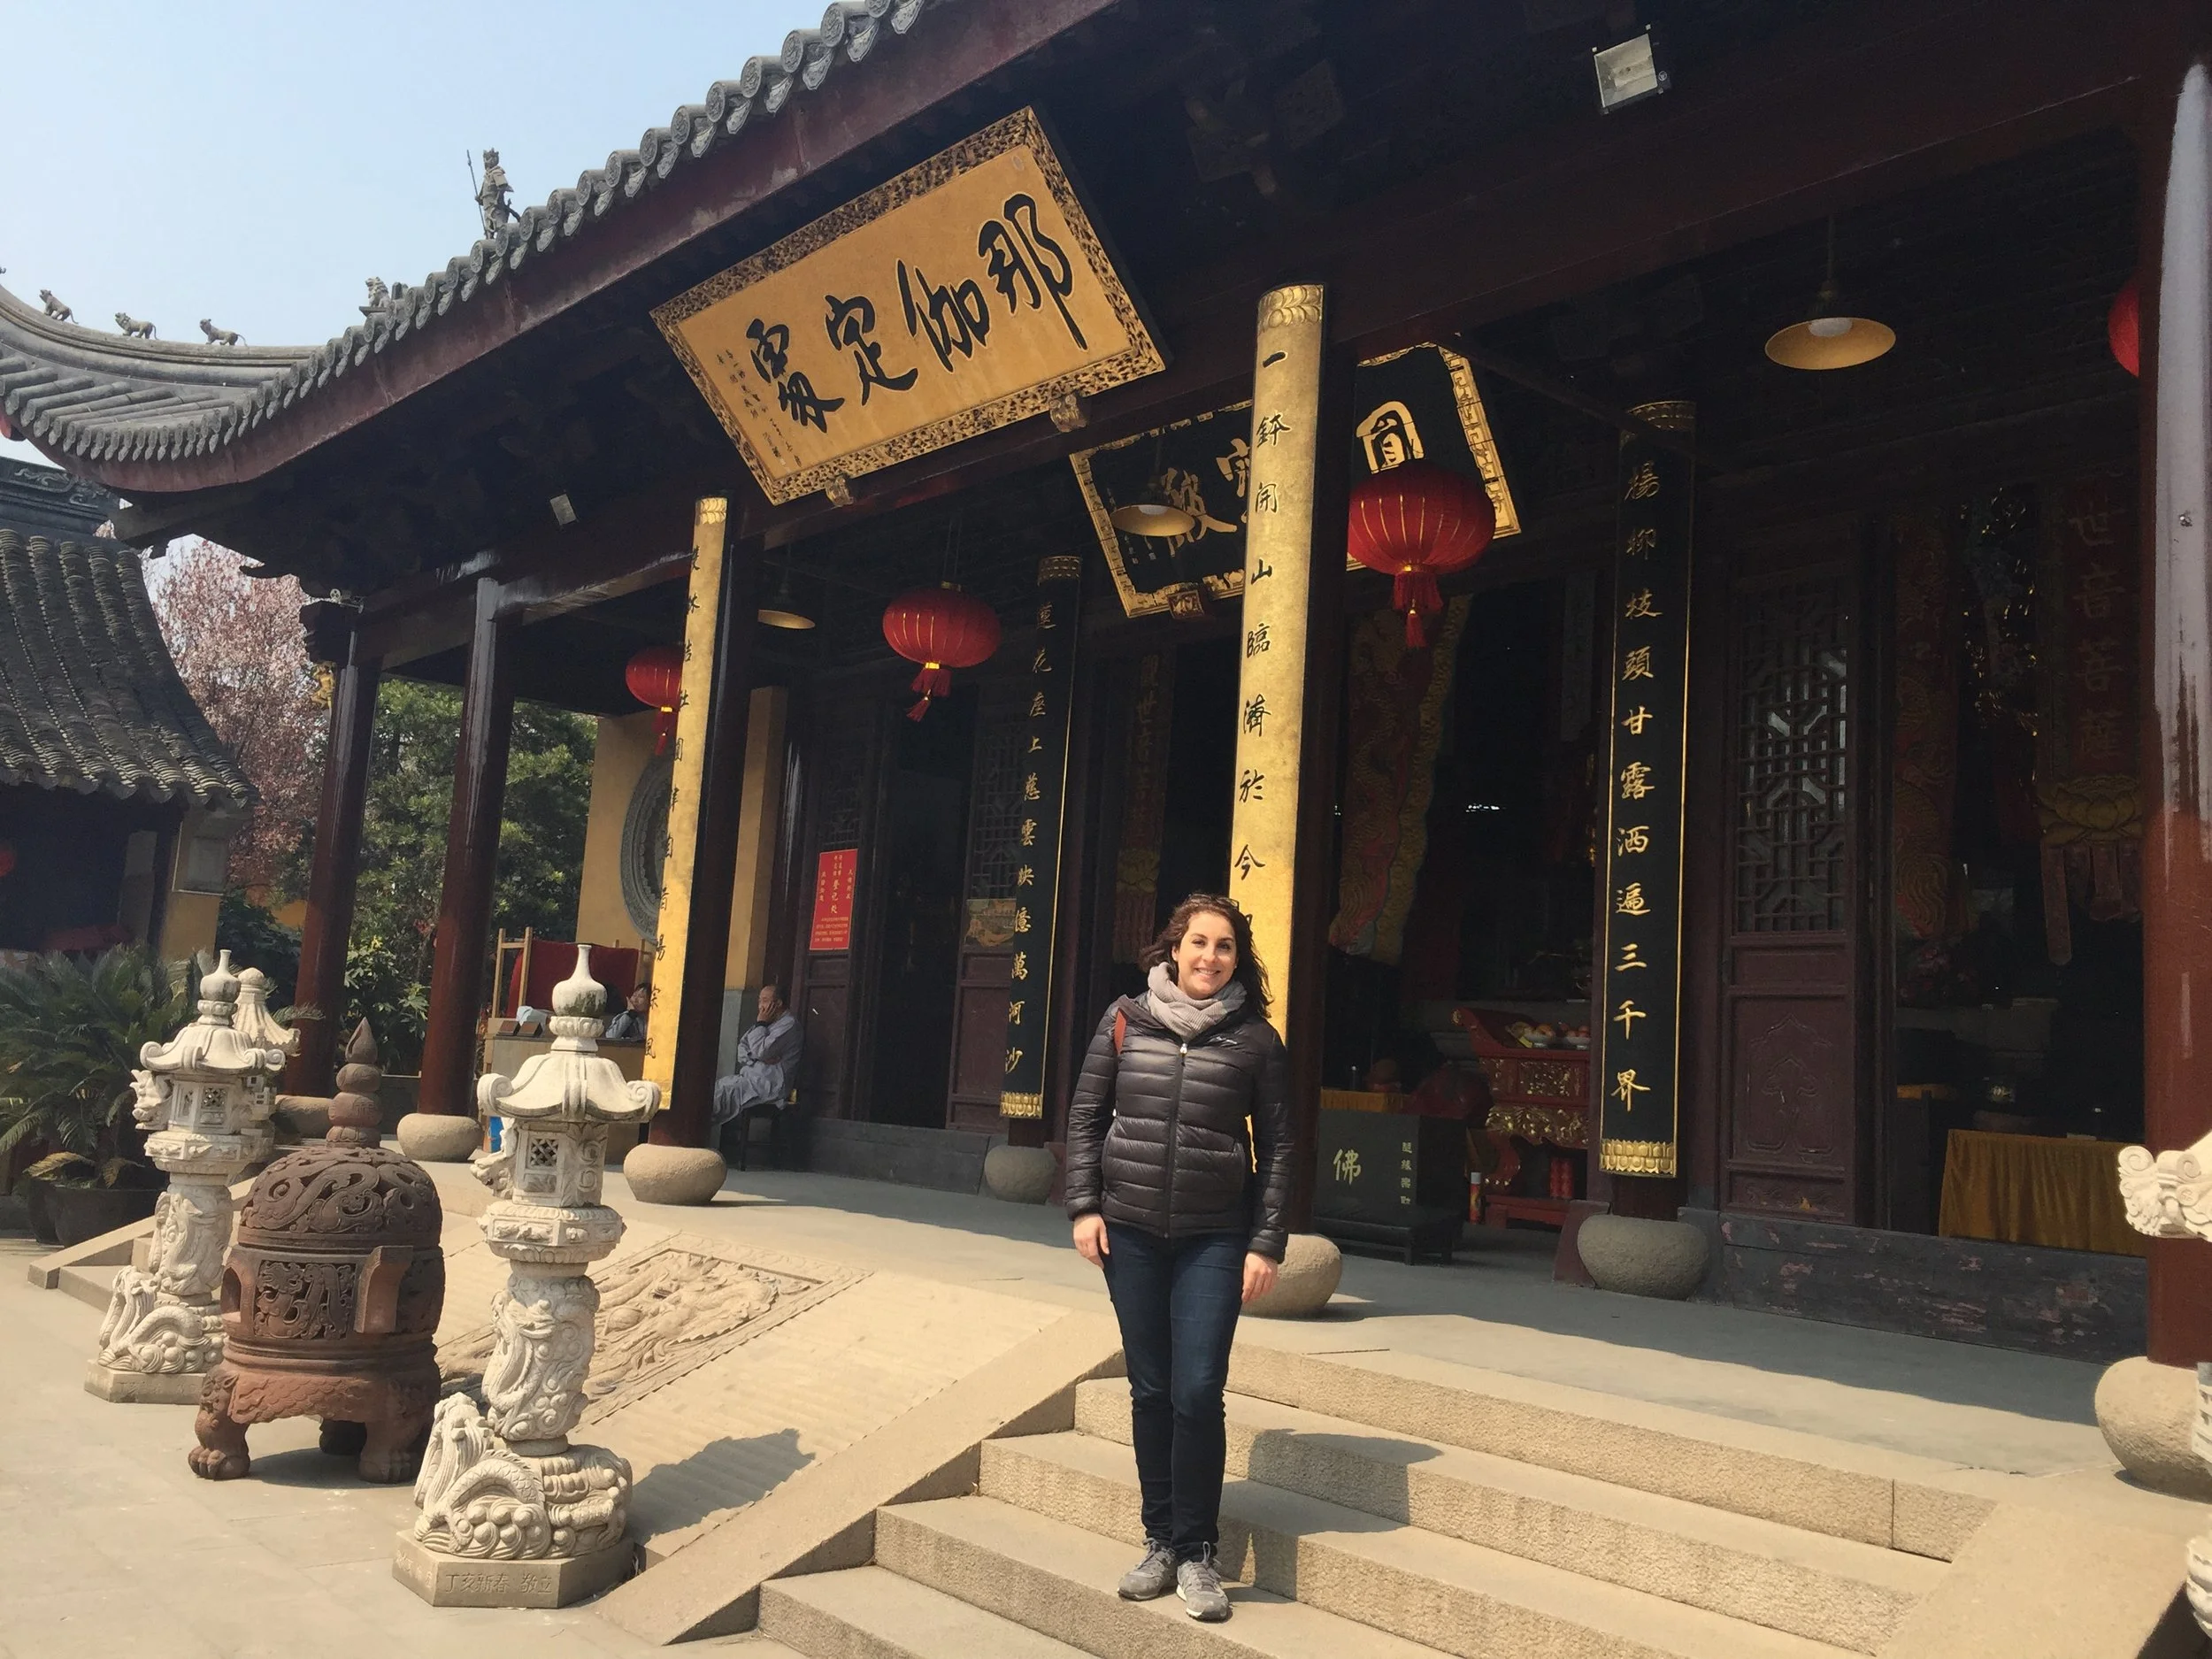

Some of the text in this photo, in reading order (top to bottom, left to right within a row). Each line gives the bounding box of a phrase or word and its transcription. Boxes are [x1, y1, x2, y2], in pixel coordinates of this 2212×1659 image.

[1234, 351, 1291, 940] 一鉢開山臨濟於今
[1333, 1148, 1362, 1186] 佛
[445, 1572, 553, 1594] 丁亥新春 敬立
